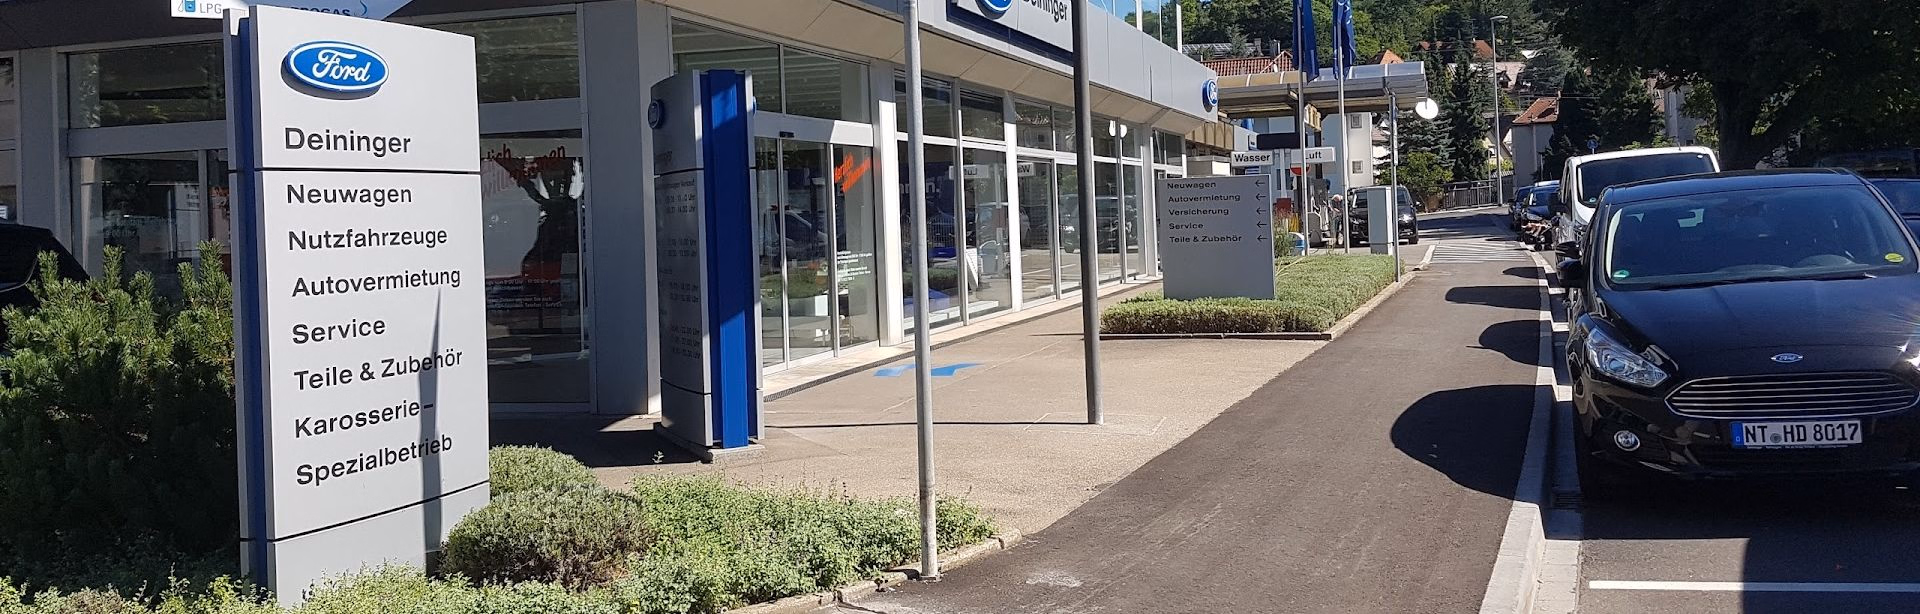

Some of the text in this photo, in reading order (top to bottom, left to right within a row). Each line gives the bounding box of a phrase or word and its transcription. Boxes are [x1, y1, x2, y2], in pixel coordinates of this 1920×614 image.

[200, 4, 222, 15] LPG
[312, 49, 372, 82] Ford
[285, 127, 411, 158] Deininger
[1234, 153, 1271, 163] Wasser
[1305, 151, 1322, 160] uft
[287, 184, 412, 207] Neuwagen
[1167, 182, 1216, 190] Neuwagen
[1168, 194, 1240, 203] Autovermietung
[1168, 208, 1229, 216] Versicherung
[289, 228, 448, 251] Nutzfahrzeuge
[1202, 235, 1242, 243] Zubehör
[292, 269, 461, 297] Autovermietung
[292, 319, 386, 344] Service
[294, 348, 463, 391] Teile & Zubehör
[1744, 423, 1859, 443] NT HD 8017
[296, 434, 453, 486] Spezialbetrieb
